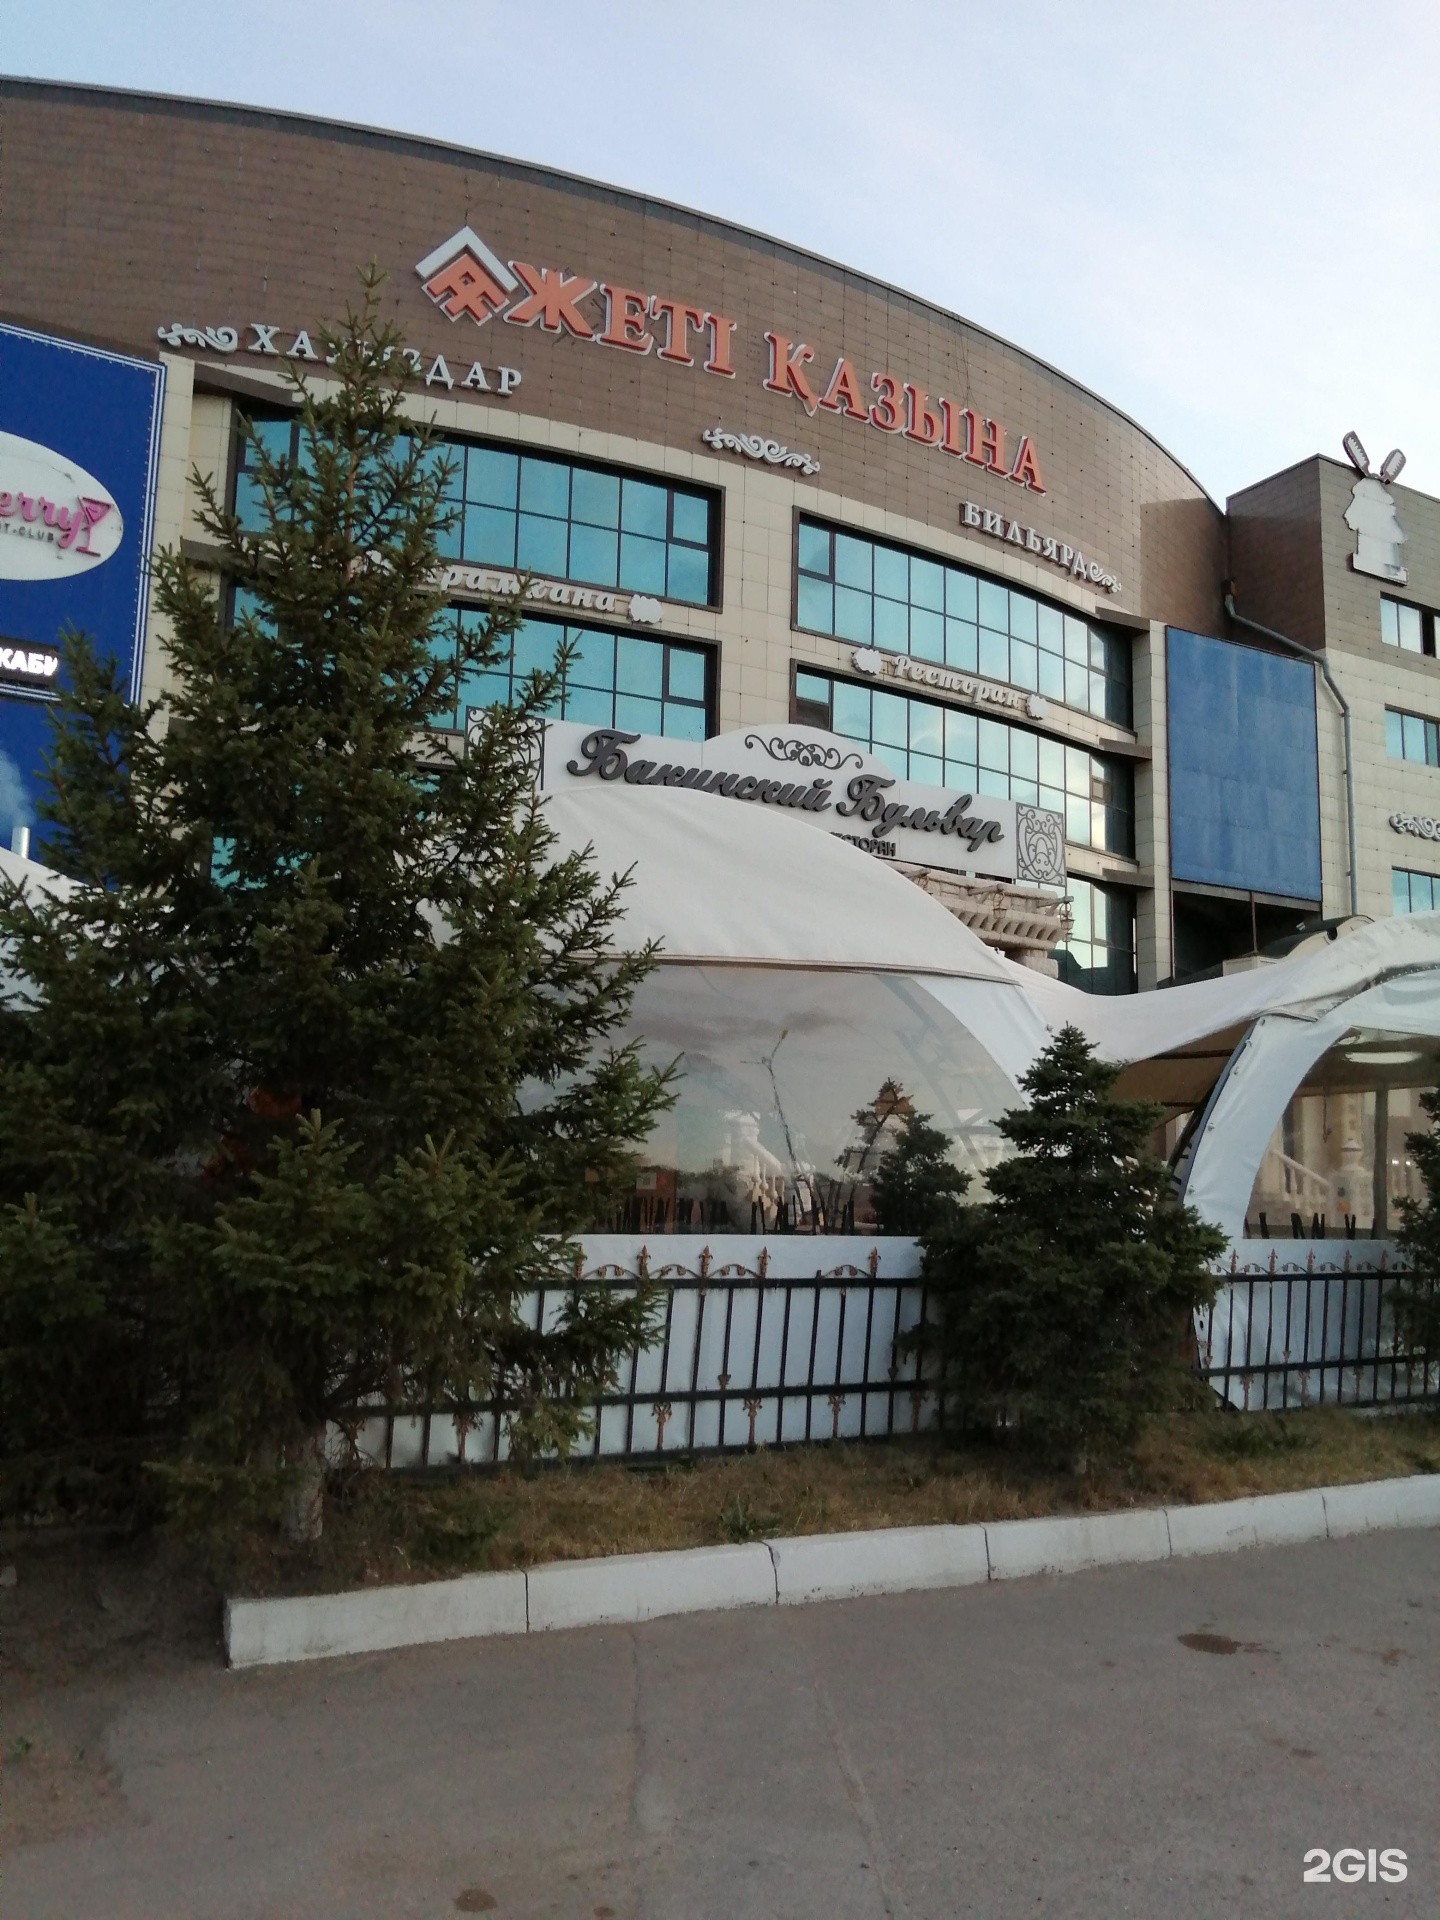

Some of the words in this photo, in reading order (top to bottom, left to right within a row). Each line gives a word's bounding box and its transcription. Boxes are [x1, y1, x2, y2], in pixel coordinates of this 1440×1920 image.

[503, 260, 737, 379] ЖЕТІ
[763, 332, 1046, 496] ҚАЗЫНА
[961, 501, 1087, 580] БИЛЬЯРД
[892, 655, 1021, 704] Ресторан
[567, 729, 832, 812] Бакинский
[836, 774, 1004, 852] Бульвар
